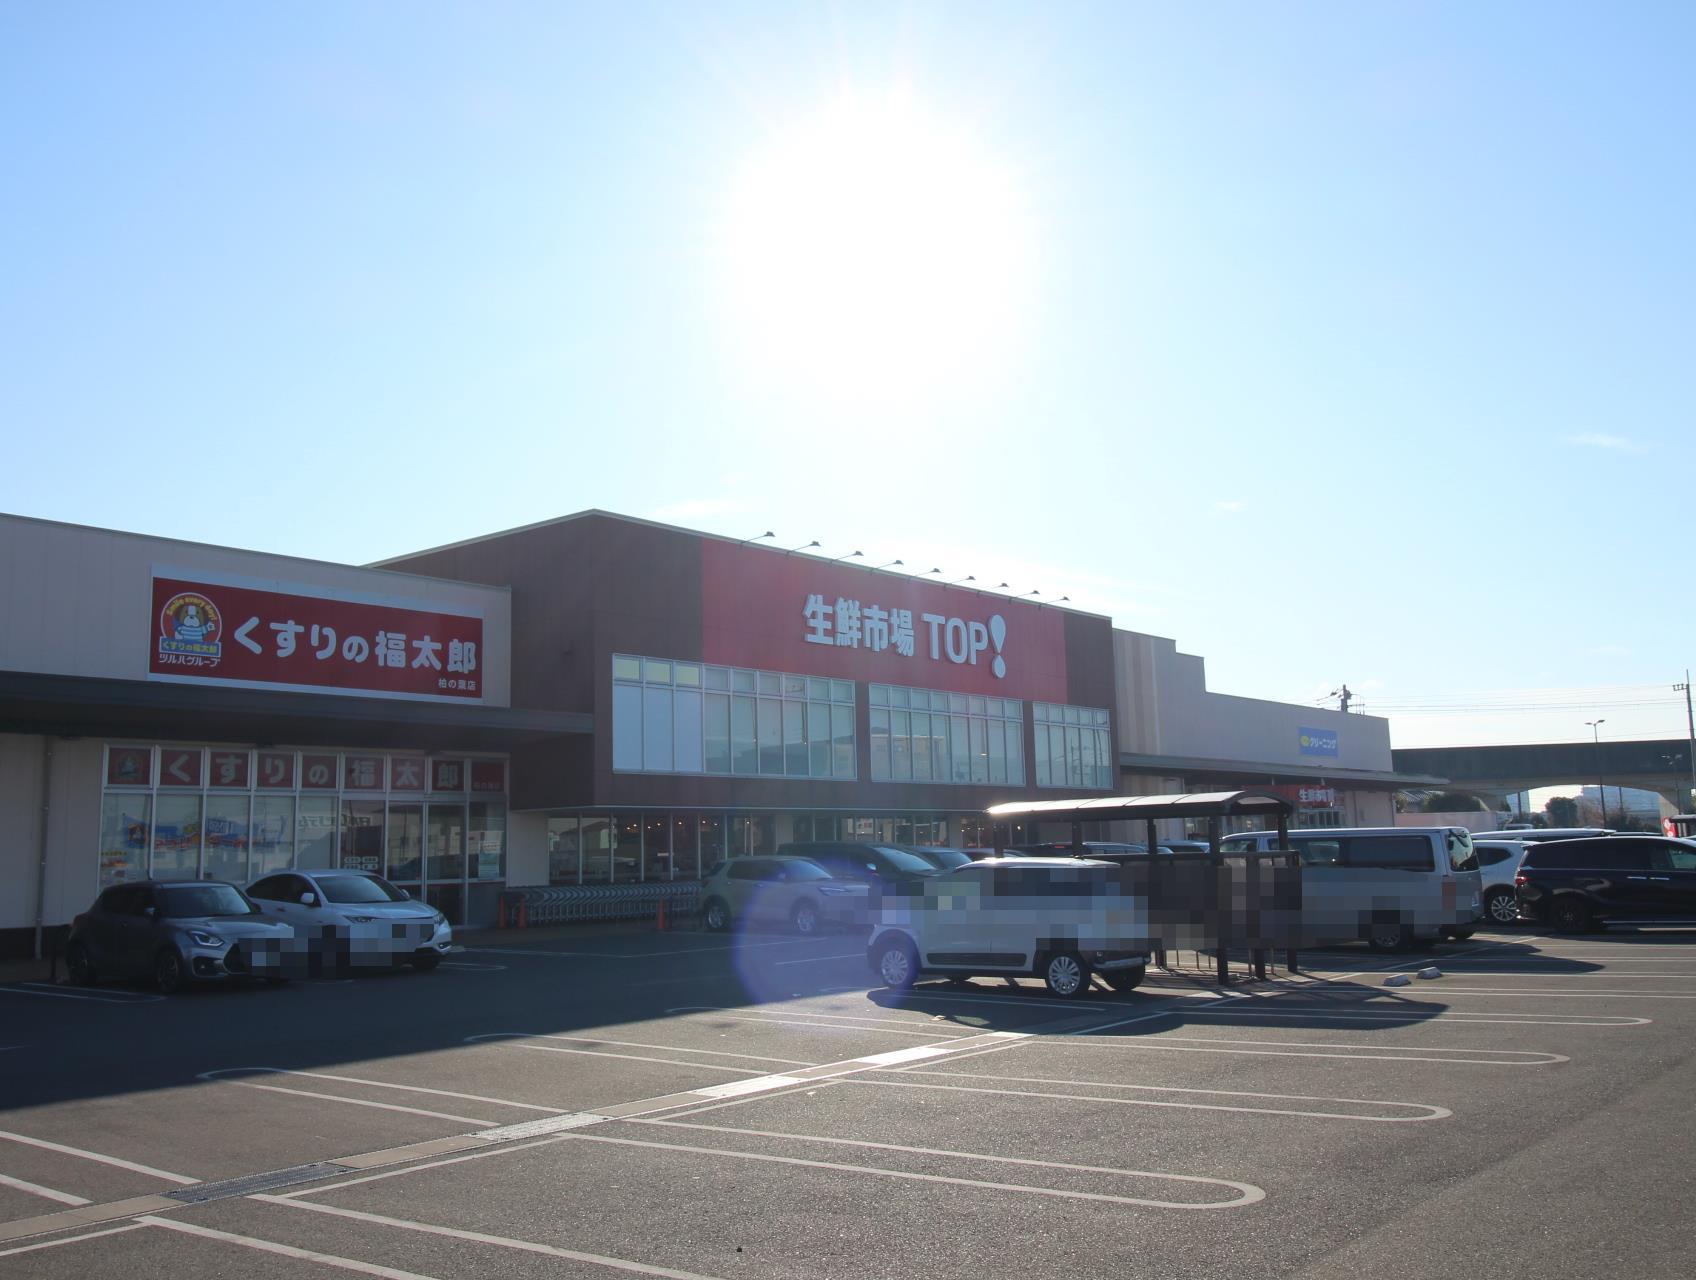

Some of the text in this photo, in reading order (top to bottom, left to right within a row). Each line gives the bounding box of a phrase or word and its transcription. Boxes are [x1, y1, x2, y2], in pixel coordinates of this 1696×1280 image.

[234, 617, 476, 674] くすりの福太郎
[803, 594, 1006, 678] 生鮮市場 TOP!
